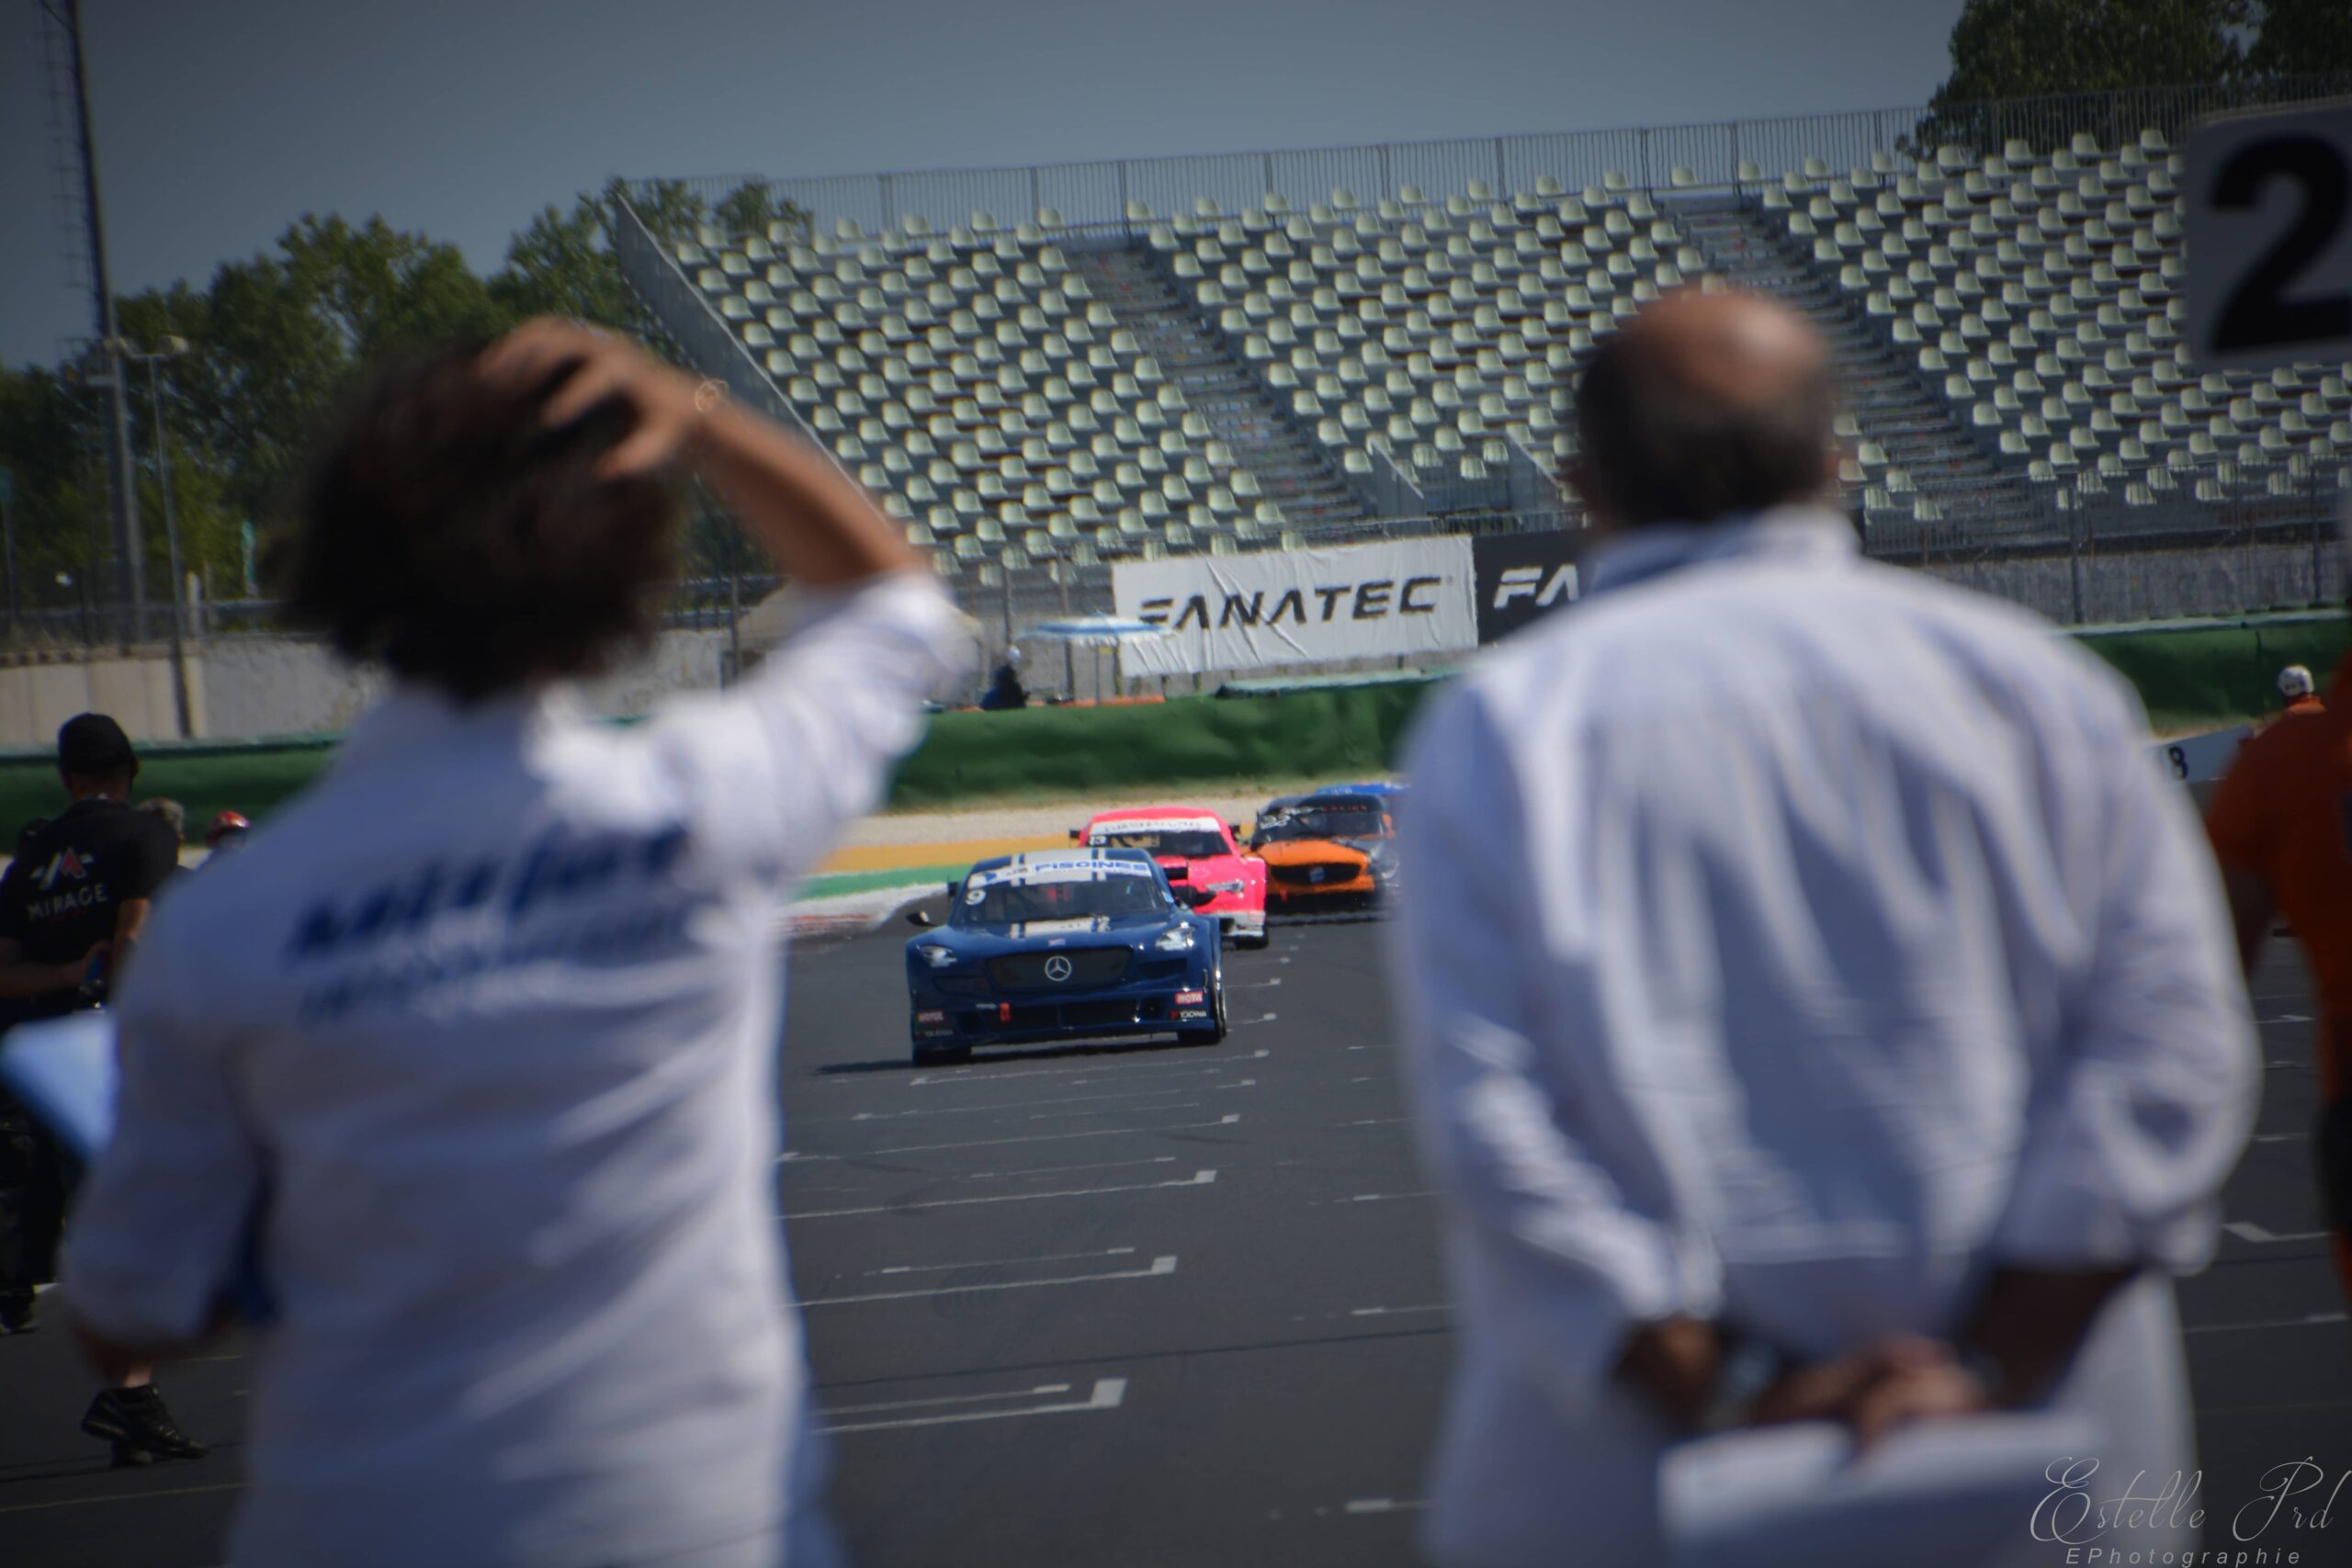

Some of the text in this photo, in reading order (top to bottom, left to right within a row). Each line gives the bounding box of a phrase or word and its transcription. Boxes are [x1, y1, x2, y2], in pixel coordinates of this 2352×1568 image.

[2210, 133, 2352, 355] 2
[1140, 575, 1442, 631] FANATEC
[26, 882, 109, 921] MIRAGE
[965, 888, 987, 906] 9
